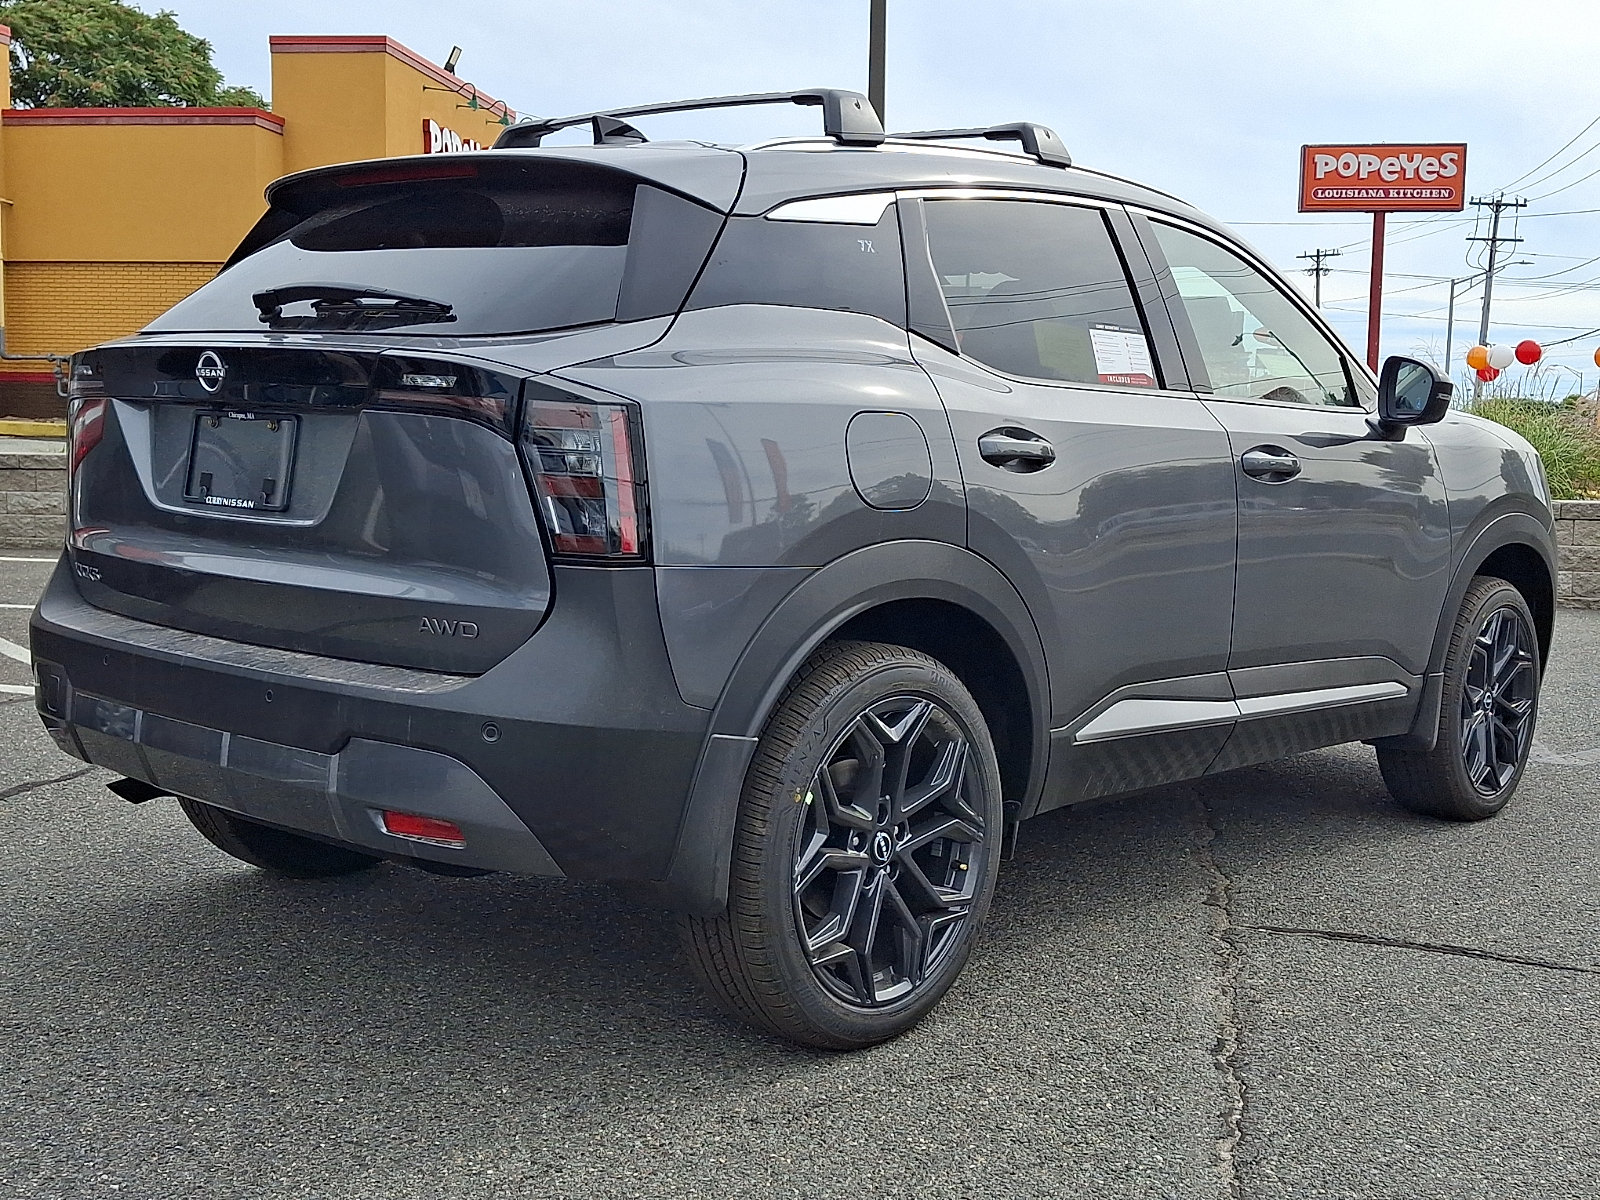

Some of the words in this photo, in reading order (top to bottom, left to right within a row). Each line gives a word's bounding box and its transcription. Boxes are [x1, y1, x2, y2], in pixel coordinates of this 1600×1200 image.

[1317, 188, 1385, 198] LOUISIANA
[1389, 188, 1450, 198] KITCHEN
[223, 497, 255, 508] NISSAN
[419, 615, 480, 639] AWD
